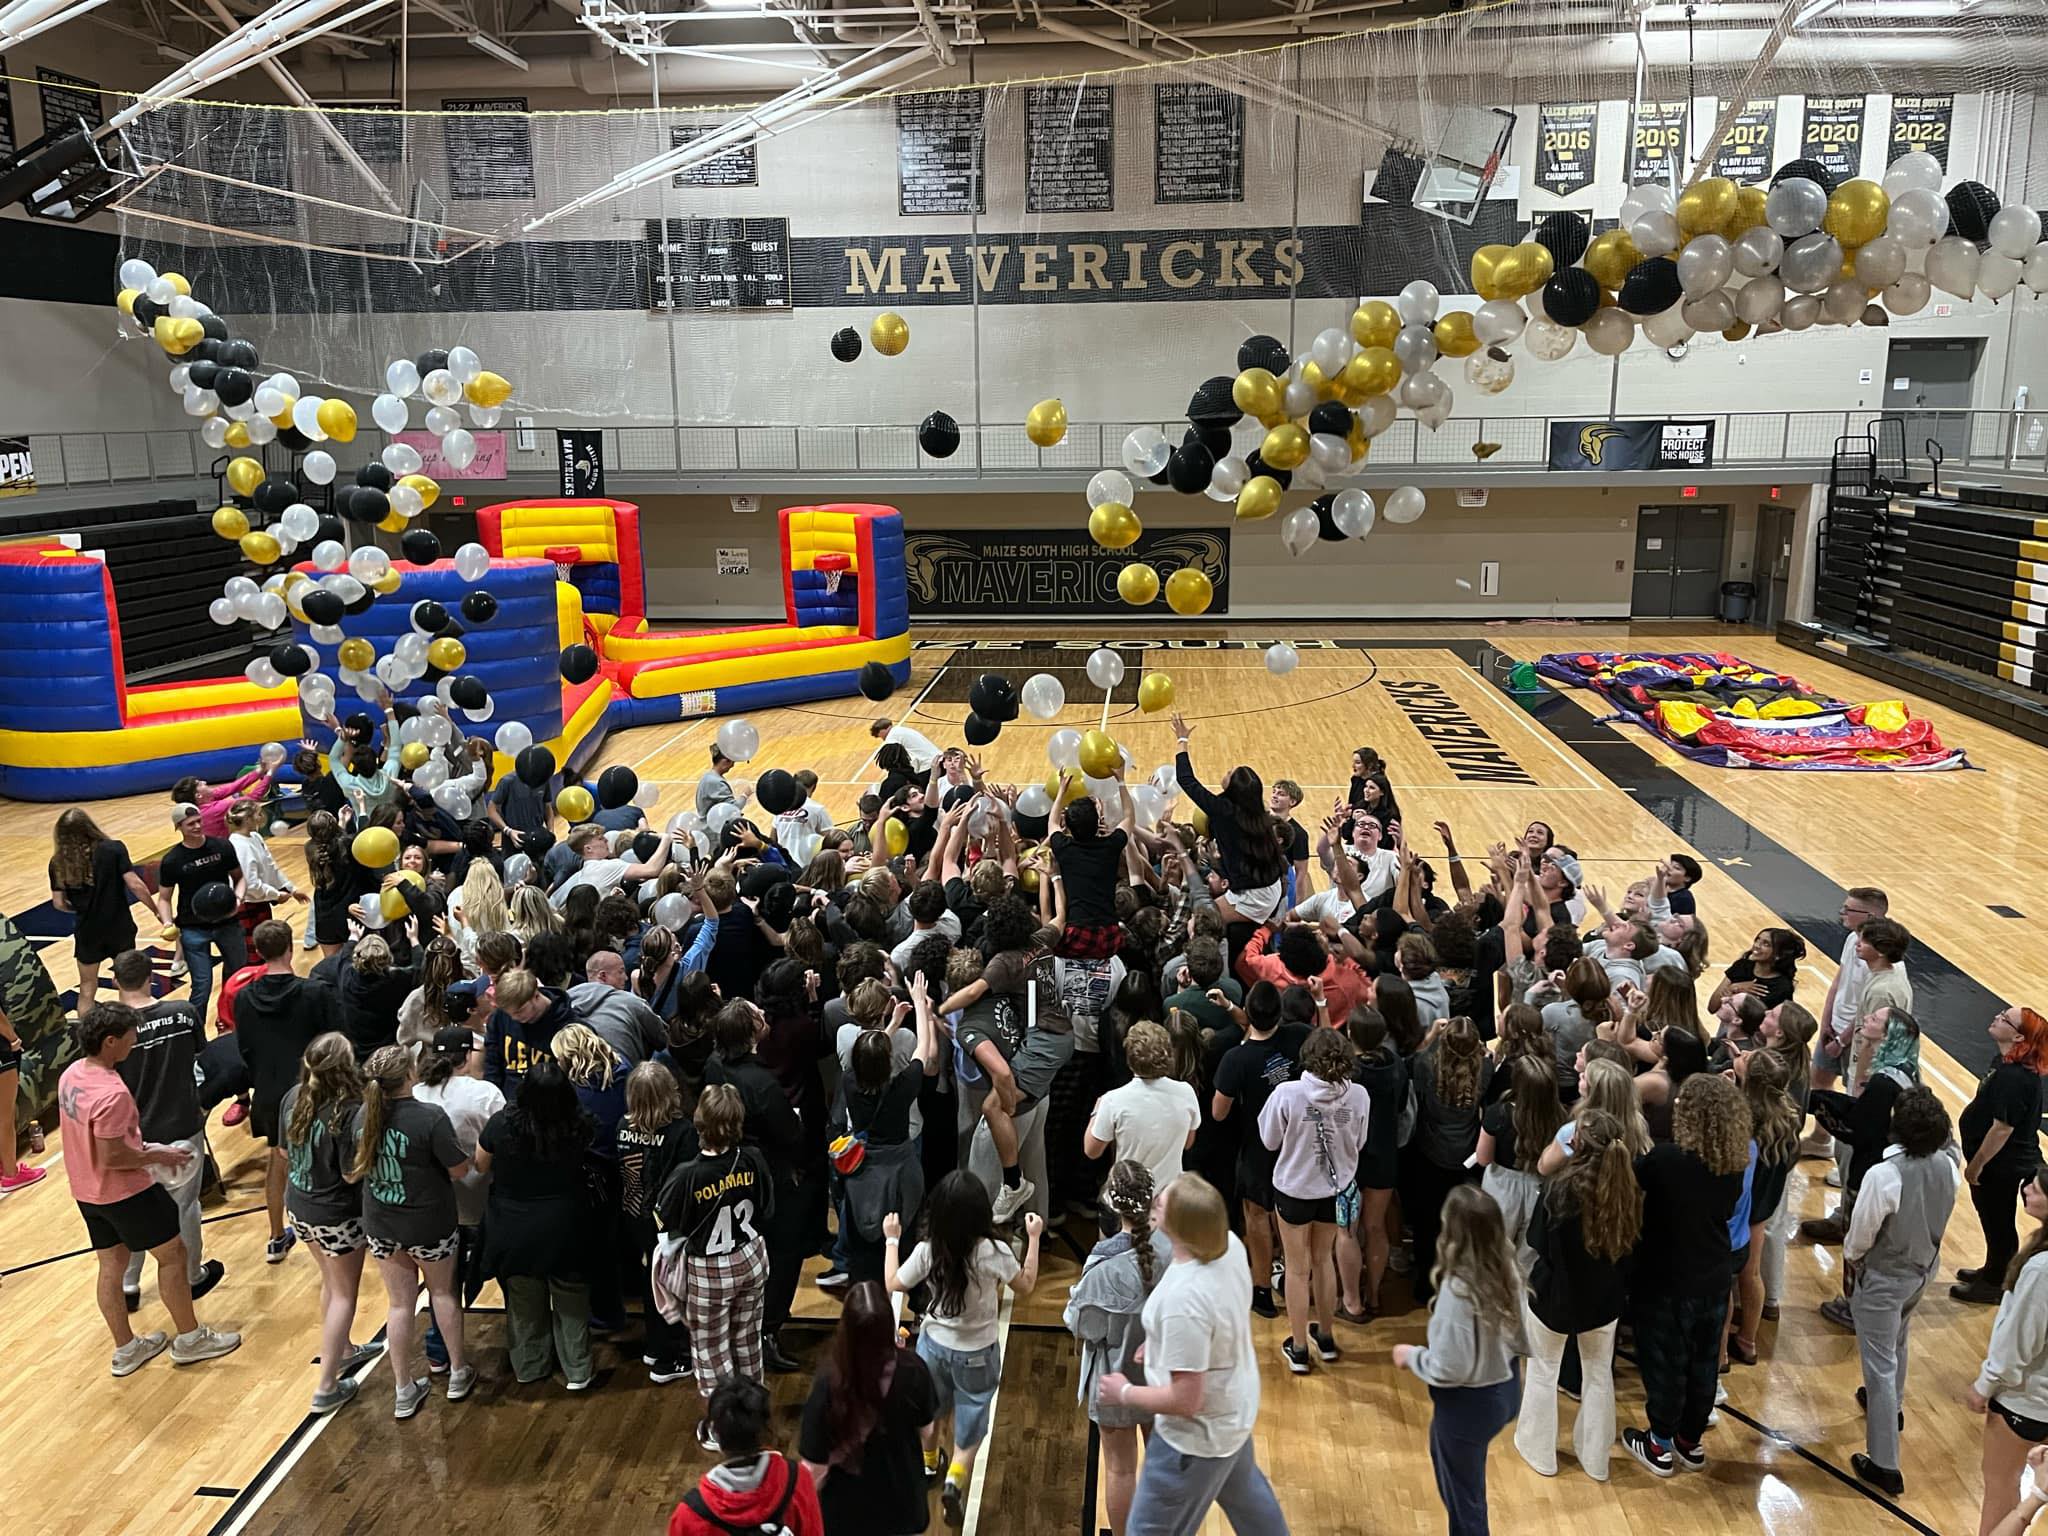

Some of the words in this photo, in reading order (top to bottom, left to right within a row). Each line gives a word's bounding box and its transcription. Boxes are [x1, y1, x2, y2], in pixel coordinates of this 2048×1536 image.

[1636, 127, 1680, 148] 2016
[1721, 126, 1769, 146] 2017
[1807, 123, 1859, 144] 2020
[1894, 123, 1946, 142] 2022
[1544, 131, 1590, 151] 2016
[1746, 156, 1766, 166] STATE
[1825, 154, 1845, 164] STATE
[1561, 162, 1580, 171] STATE
[1721, 165, 1762, 176] CHAMPIONS
[1545, 172, 1585, 181] CHAMPIONS
[751, 241, 778, 252] GUEST
[845, 239, 1304, 294] MAVERICKS
[1661, 438, 1707, 450] PROTECT
[1661, 451, 1678, 460] THIS
[562, 438, 575, 496] MAVERICKS
[982, 545, 1017, 558] MAIZE
[1018, 544, 1058, 557] SOUTH
[1060, 544, 1089, 557] HIGH
[1091, 543, 1139, 557] SCHOOL
[1053, 639, 1340, 650] SOUTH
[1378, 680, 1540, 786] MAVERICKS
